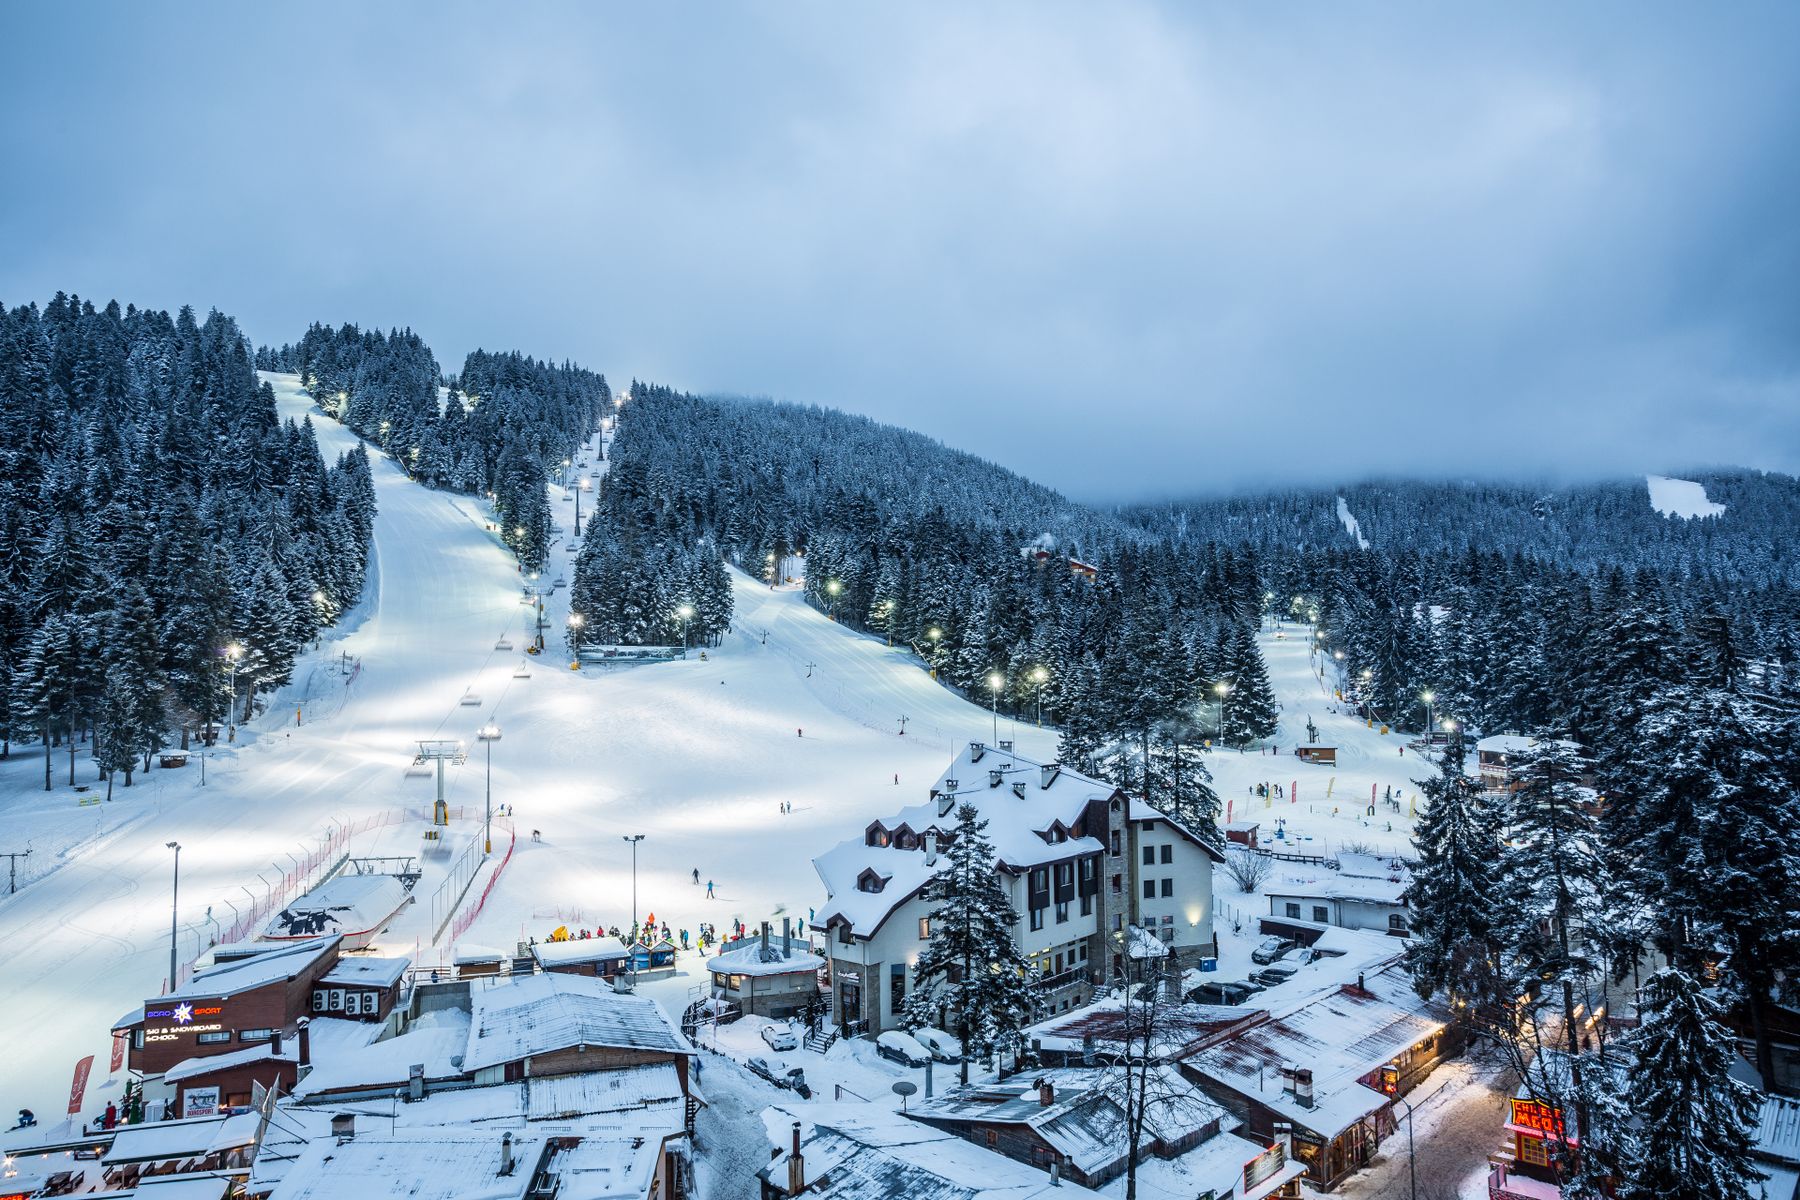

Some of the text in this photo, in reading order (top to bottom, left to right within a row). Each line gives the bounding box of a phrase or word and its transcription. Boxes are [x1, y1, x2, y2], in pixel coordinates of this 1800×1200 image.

[194, 1007, 221, 1015] SPORT
[170, 1024, 221, 1033] SNOWBOARD
[145, 1034, 179, 1042] SCHOOL
